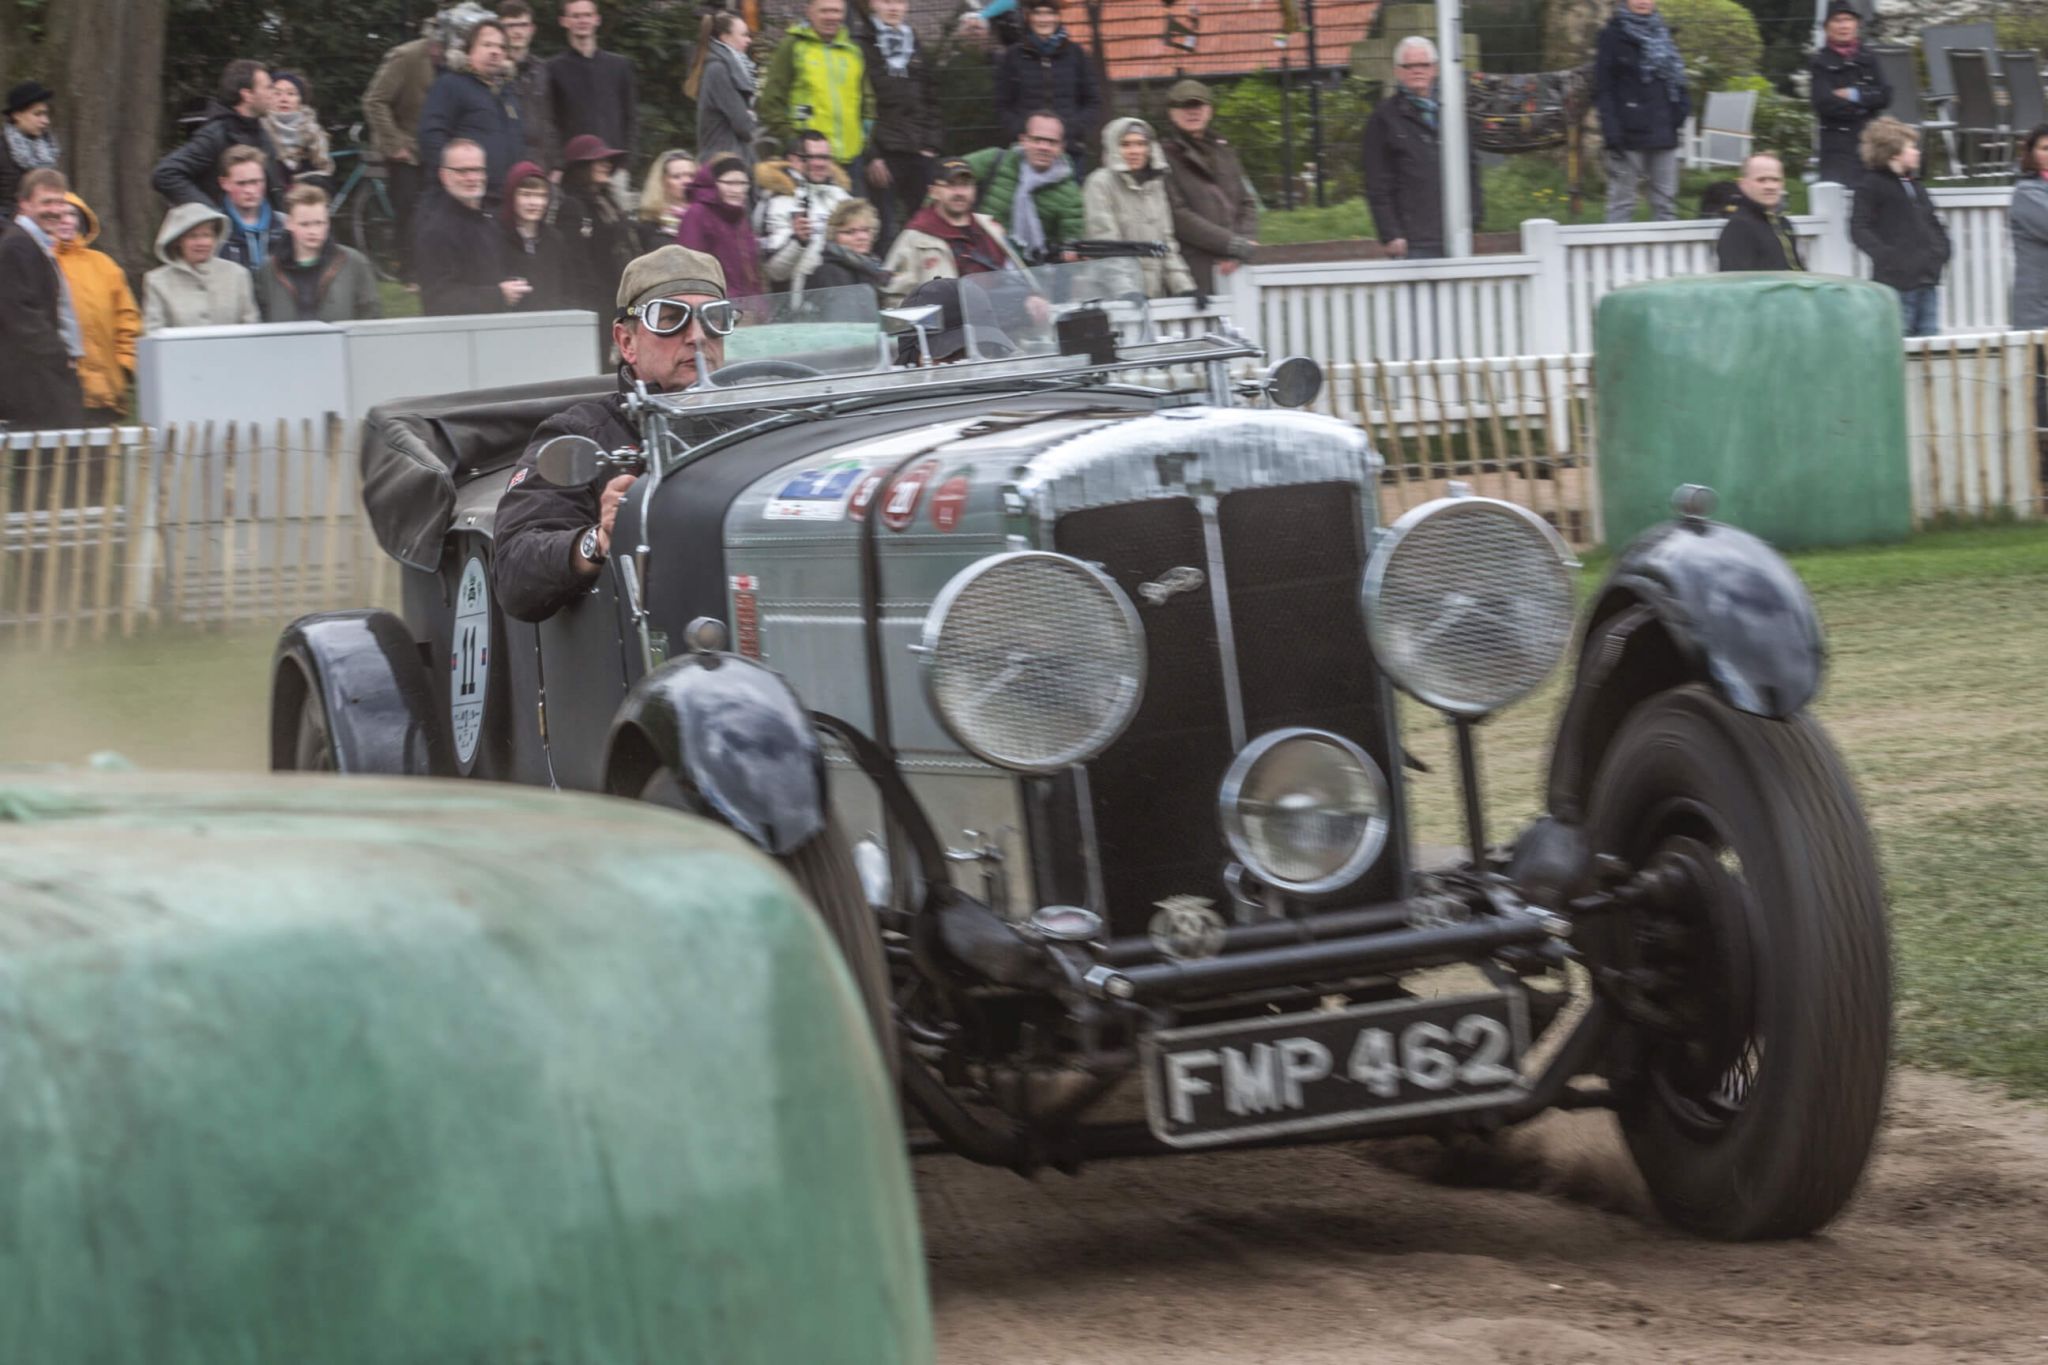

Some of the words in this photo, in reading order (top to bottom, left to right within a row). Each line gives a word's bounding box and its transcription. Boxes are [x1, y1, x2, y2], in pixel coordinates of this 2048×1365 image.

[460, 627, 476, 695] 11
[1165, 1037, 1333, 1124] FMP
[1348, 1014, 1518, 1098] 462
